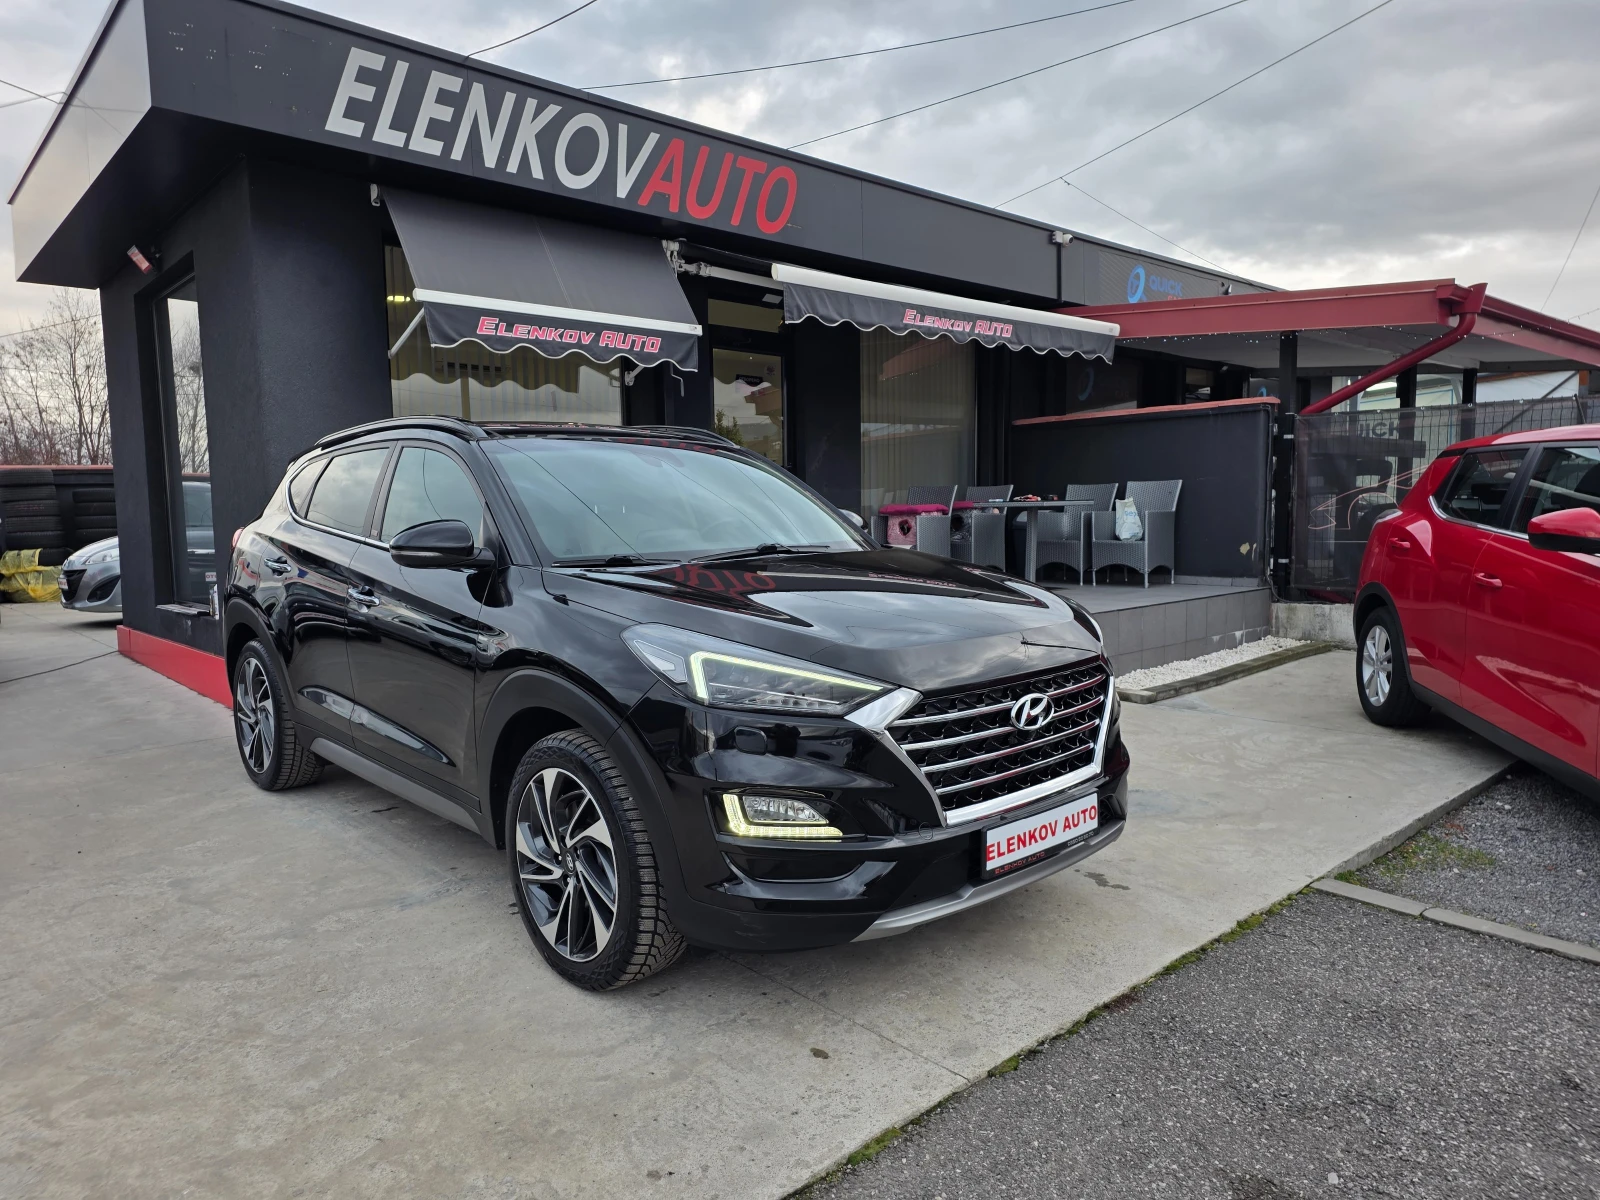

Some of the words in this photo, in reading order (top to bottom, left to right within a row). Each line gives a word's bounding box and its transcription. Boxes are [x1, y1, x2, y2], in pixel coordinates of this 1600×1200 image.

[1149, 274, 1183, 297] QUICK
[476, 316, 595, 345] ELENKOV
[599, 330, 662, 353] AUTO
[902, 308, 973, 333] ELENKOV
[974, 319, 1013, 338] AUTO
[986, 819, 1059, 863] ELENKOV
[1062, 805, 1098, 833] AUTO
